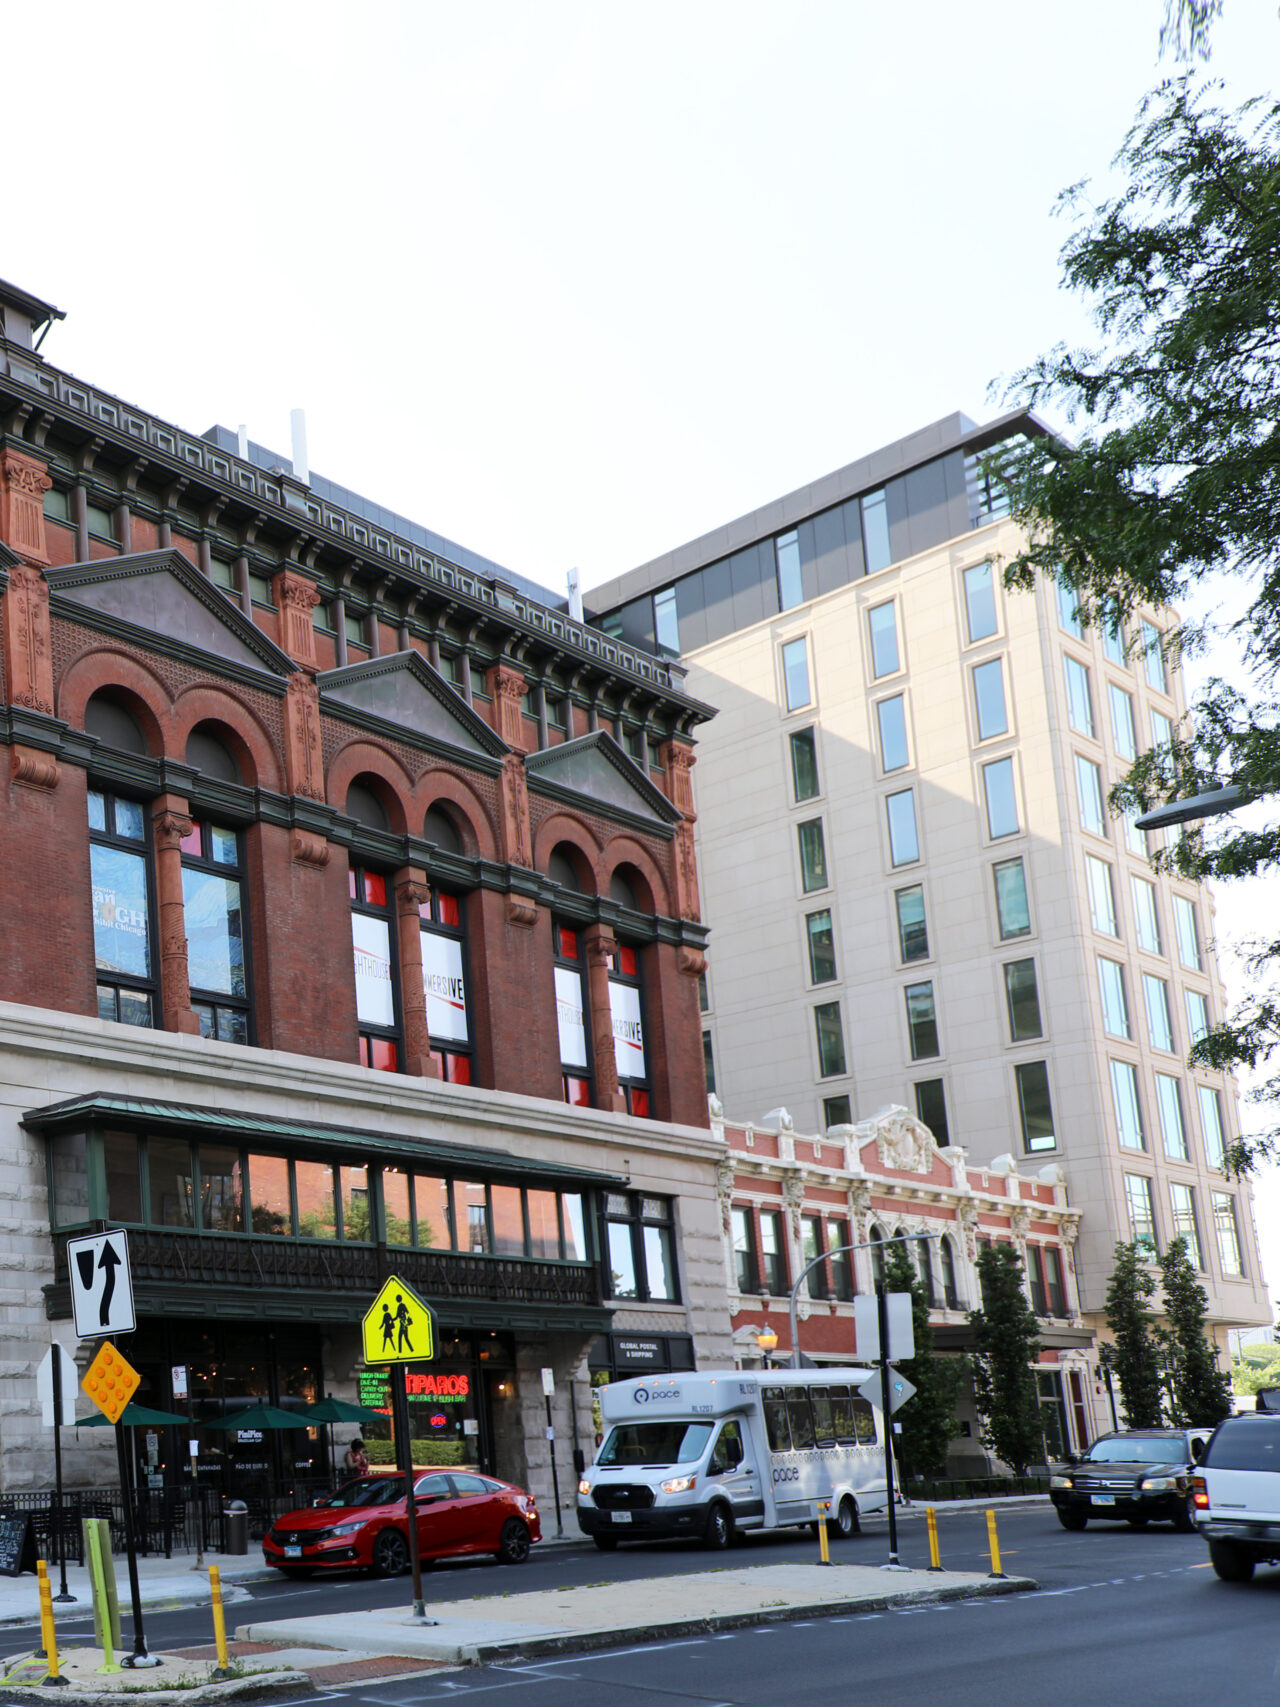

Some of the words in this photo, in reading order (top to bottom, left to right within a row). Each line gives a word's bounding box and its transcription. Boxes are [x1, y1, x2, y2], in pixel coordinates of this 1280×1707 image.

[620, 1342, 638, 1350] GLOBAL
[639, 1343, 659, 1351] POSTAL
[631, 1351, 653, 1359] SHIPPING
[405, 1374, 469, 1395] TIPAROS
[652, 1390, 680, 1400] pace
[692, 1405, 713, 1413] RL1207
[772, 1467, 799, 1485] pace
